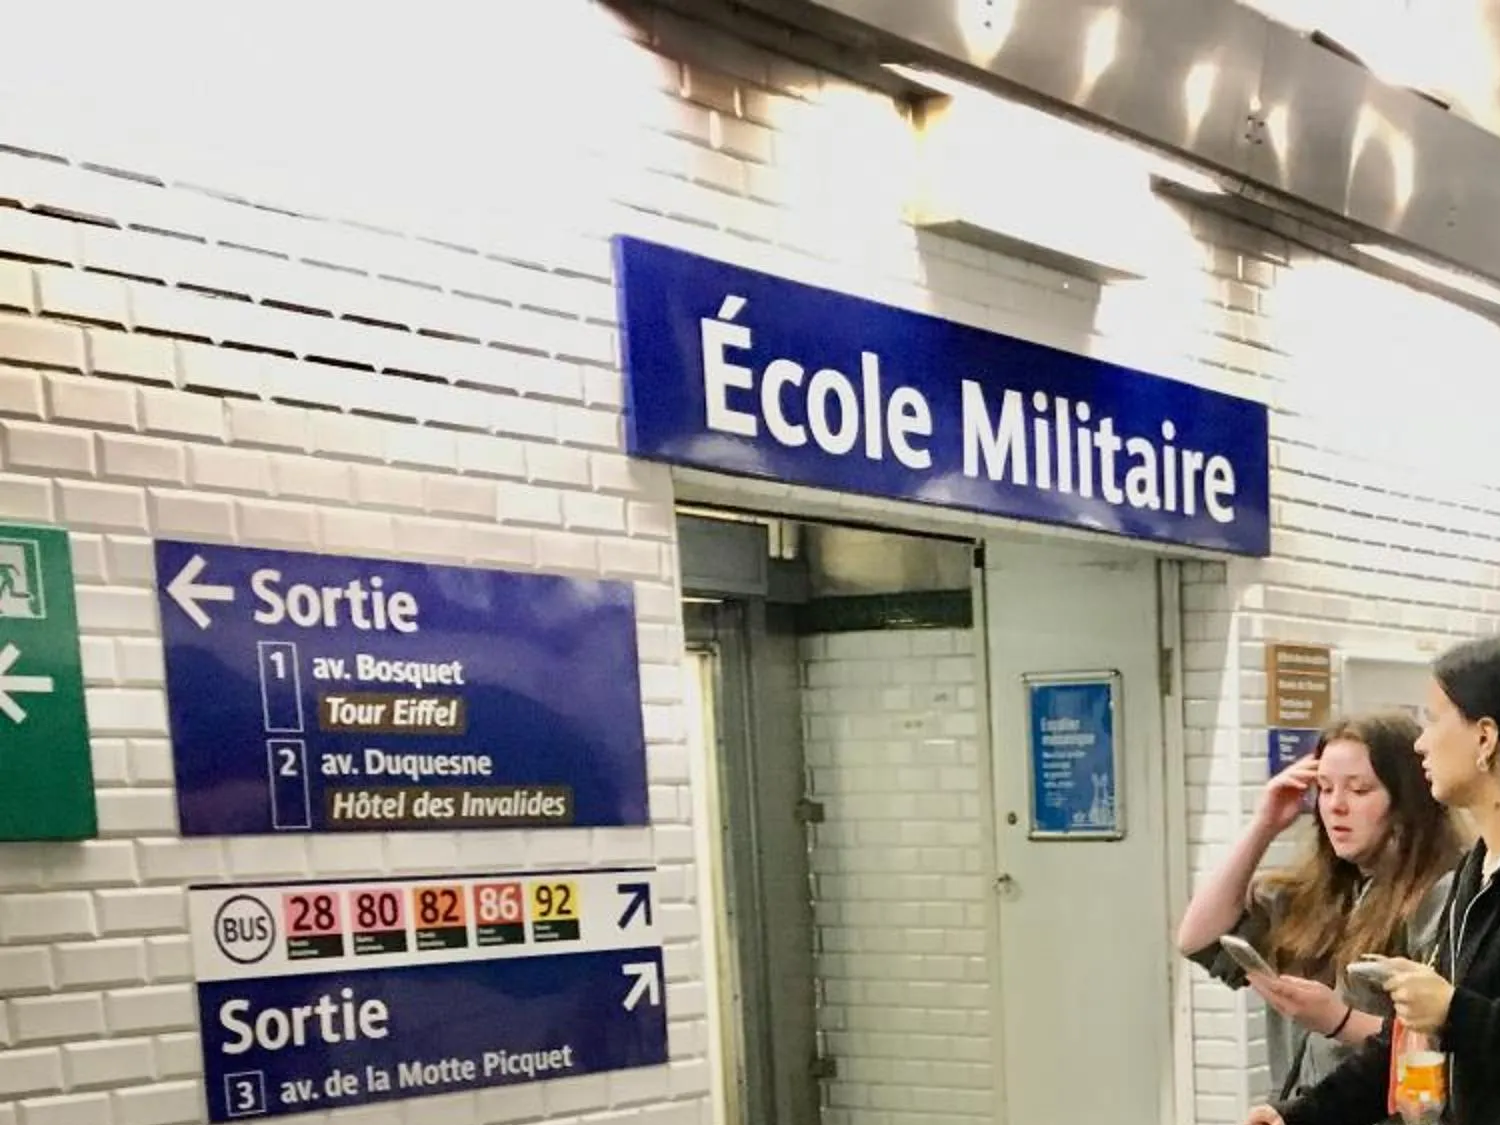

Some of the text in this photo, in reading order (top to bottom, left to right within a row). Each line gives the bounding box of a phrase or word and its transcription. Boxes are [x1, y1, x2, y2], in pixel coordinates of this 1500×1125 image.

[701, 295, 1235, 523] École Militaire
[252, 568, 419, 633] Sortie
[269, 652, 464, 689] 1 av. Bosquet
[325, 697, 457, 728] Tour Eiffel
[277, 747, 493, 782] 2 av. Duquesne
[332, 788, 566, 820] Hôtel des Invalides
[222, 884, 573, 943] BUS 28 80 82 86 92
[218, 987, 390, 1054] Sortie
[235, 1045, 573, 1109] 3 av. de la Motte Picquet
